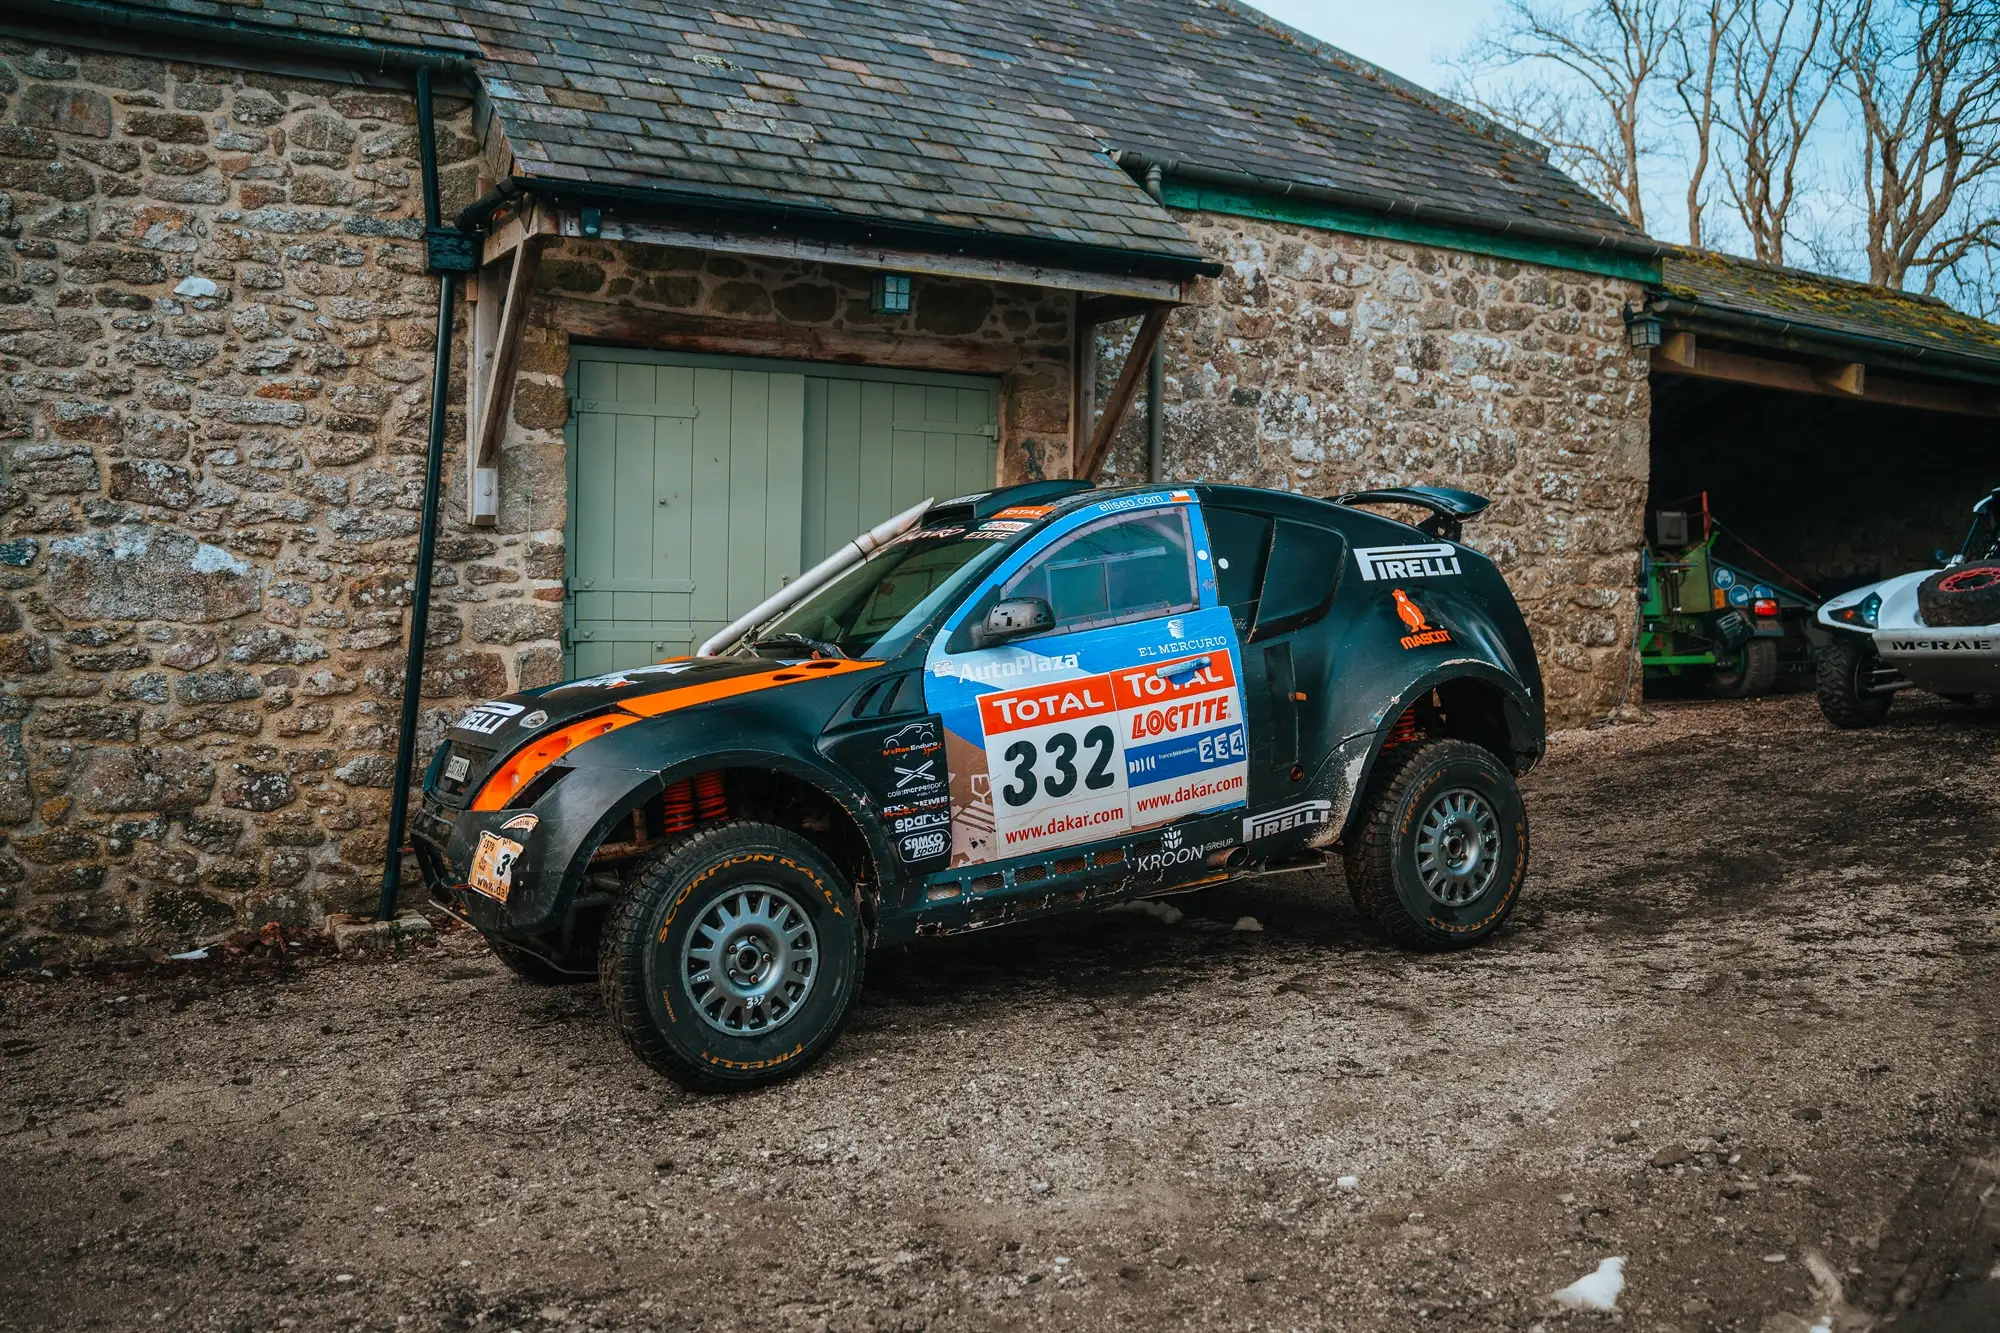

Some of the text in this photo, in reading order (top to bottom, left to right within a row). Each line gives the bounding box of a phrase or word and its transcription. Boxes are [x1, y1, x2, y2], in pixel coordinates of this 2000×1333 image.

[1099, 495, 1163, 512] eliseo.com
[963, 531, 1016, 540] EDGE
[1353, 543, 1462, 582] PIRELLI
[1138, 636, 1227, 657] EL MERCURIO
[1400, 630, 1451, 650] MASCOT
[959, 654, 1079, 684] AutoPlaza
[1123, 665, 1224, 698] TOAL
[993, 689, 1104, 724] TOTAL
[1003, 725, 1115, 807] 332
[1137, 775, 1243, 812] www.dakar.com
[1005, 807, 1124, 843] www.dakar.com
[1243, 800, 1332, 843] PIRELLI
[904, 833, 944, 851] SAMCO
[1206, 838, 1234, 851] GROUP
[1137, 845, 1203, 873] KROON
[477, 877, 508, 898] www.da
[659, 853, 845, 944] SCORPION RALLY
